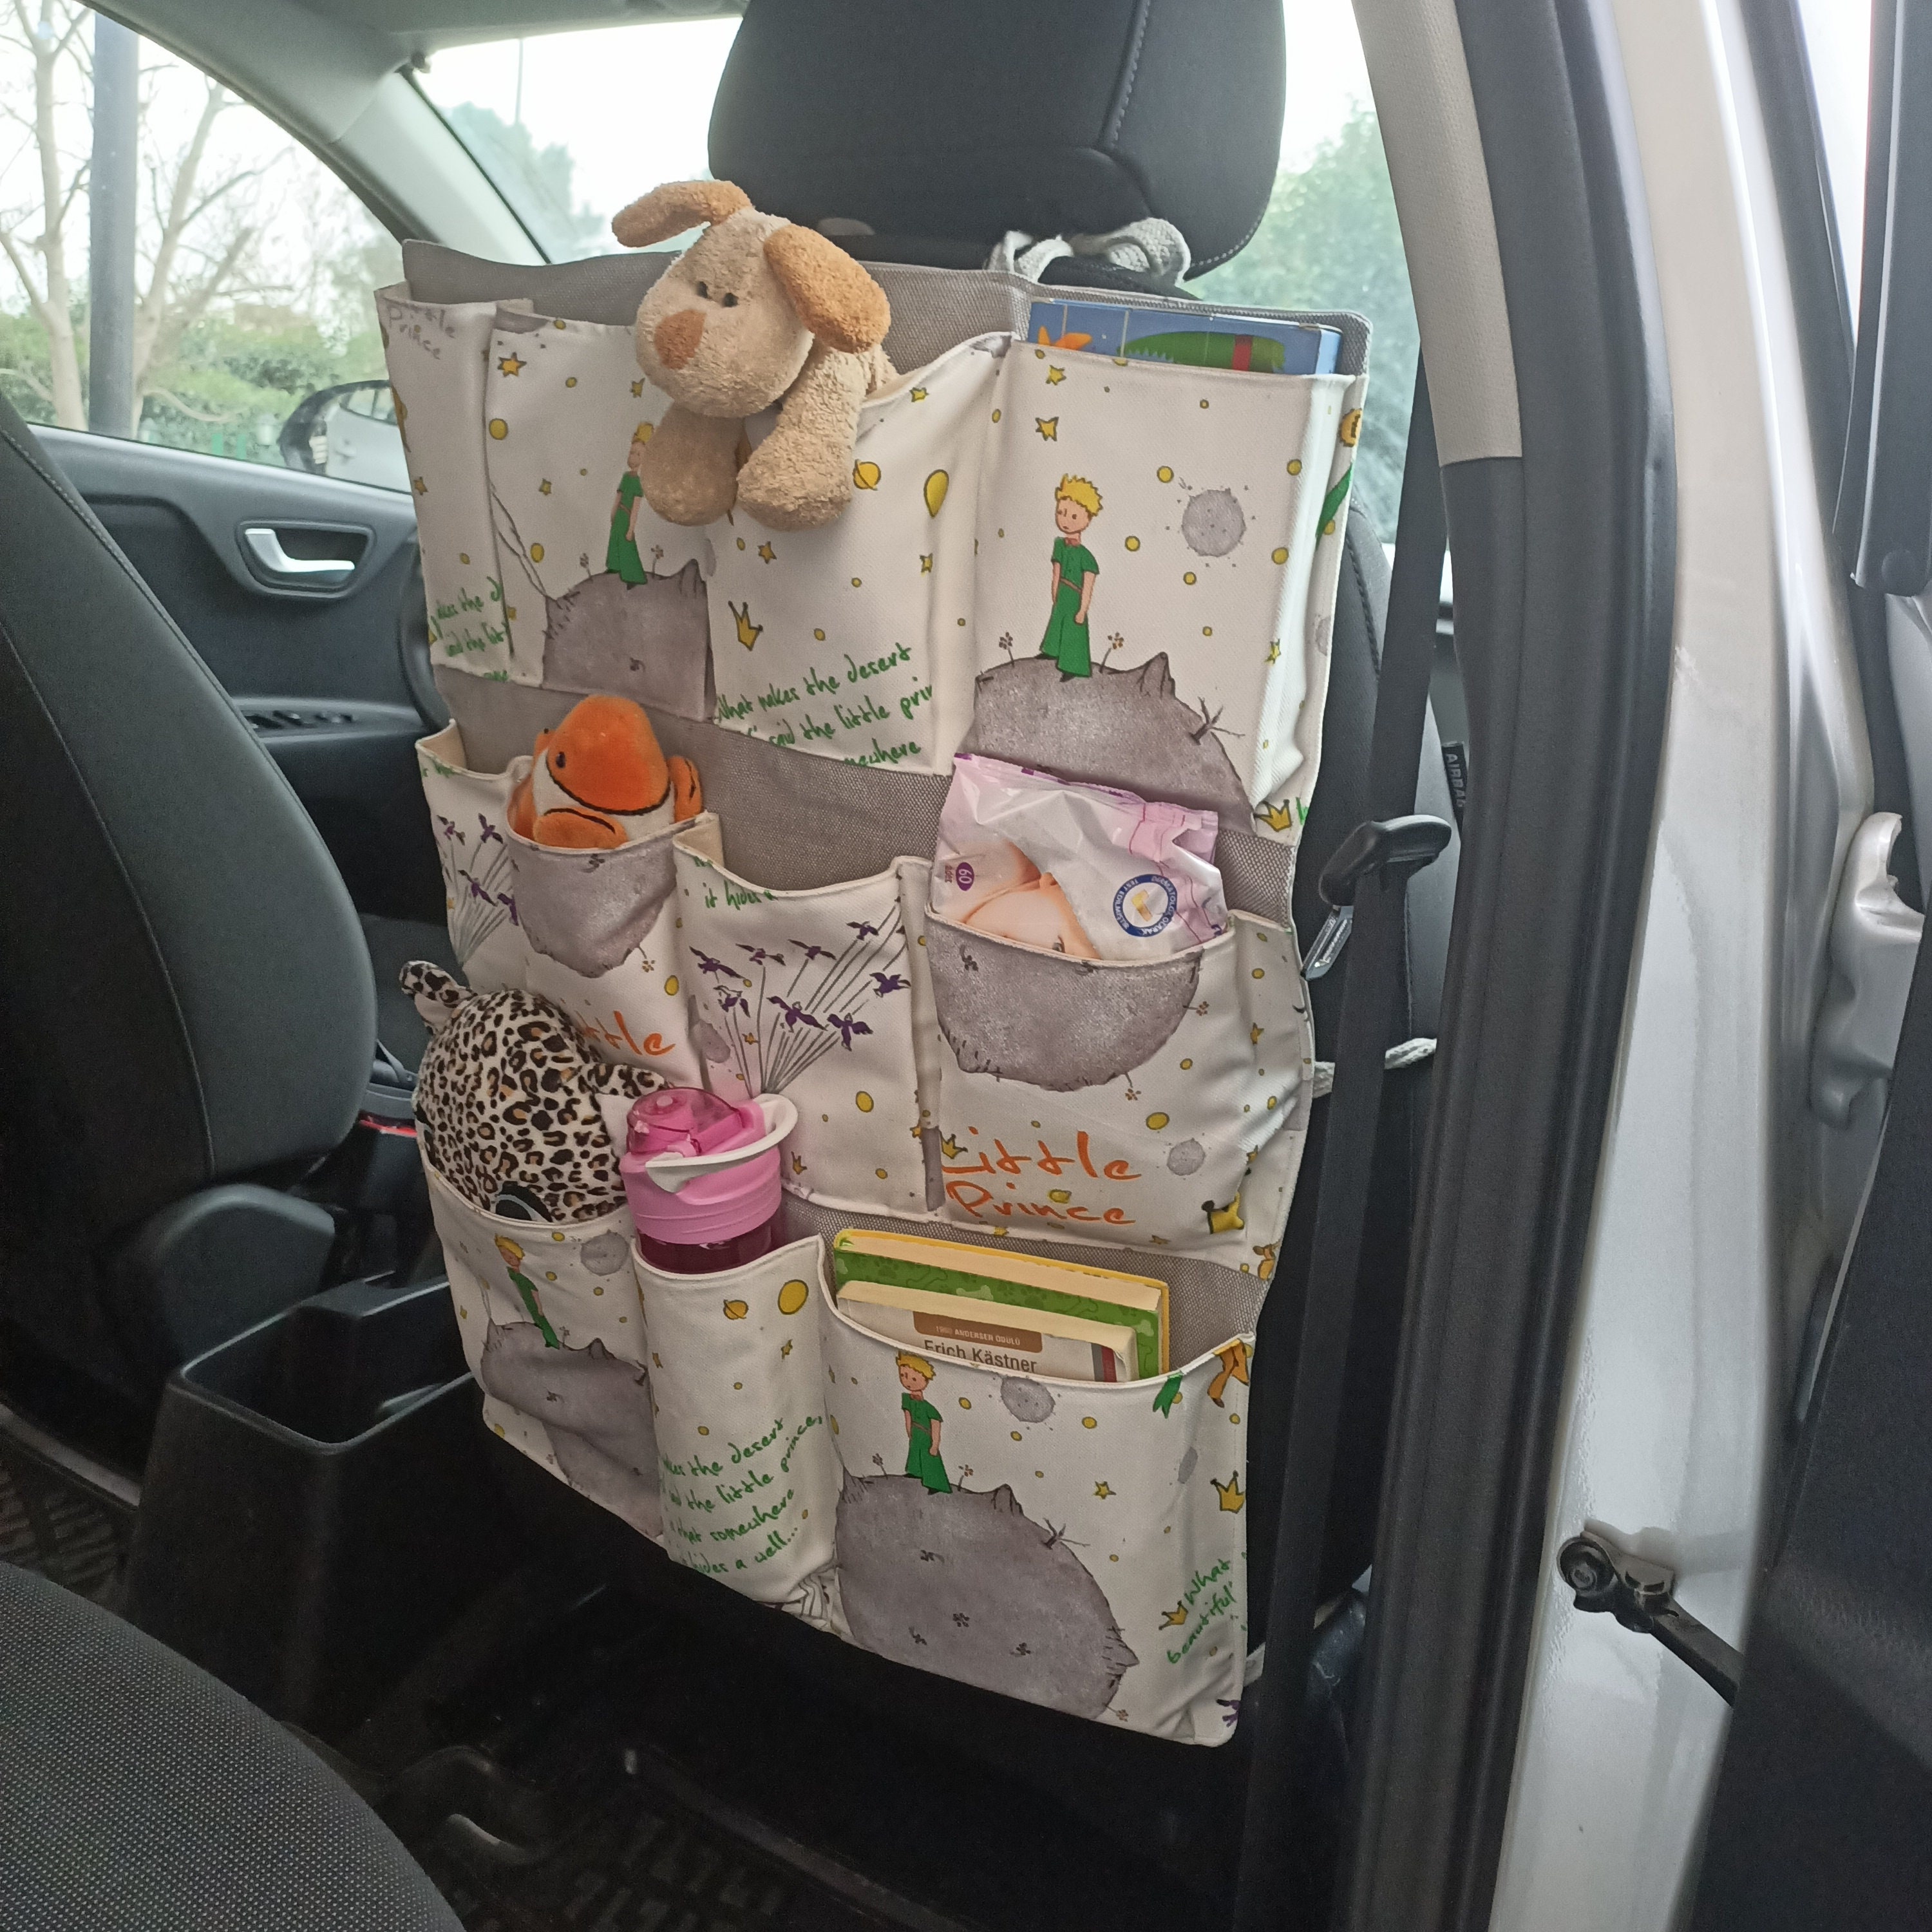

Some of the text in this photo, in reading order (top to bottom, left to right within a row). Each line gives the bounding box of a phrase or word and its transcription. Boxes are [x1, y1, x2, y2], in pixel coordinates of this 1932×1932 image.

[803, 667, 840, 695] the
[844, 642, 912, 683] desert
[799, 714, 835, 740] the
[833, 693, 890, 729] little
[958, 868, 972, 884] 60
[945, 1180, 1136, 1224] Prince
[924, 1340, 1037, 1374] Erich Kästner
[687, 1454, 724, 1477] the
[728, 1417, 784, 1464] desert
[684, 1488, 715, 1513] the
[715, 1470, 774, 1504] little
[710, 1489, 794, 1542] somewhere
[1184, 1558, 1231, 1605] What
